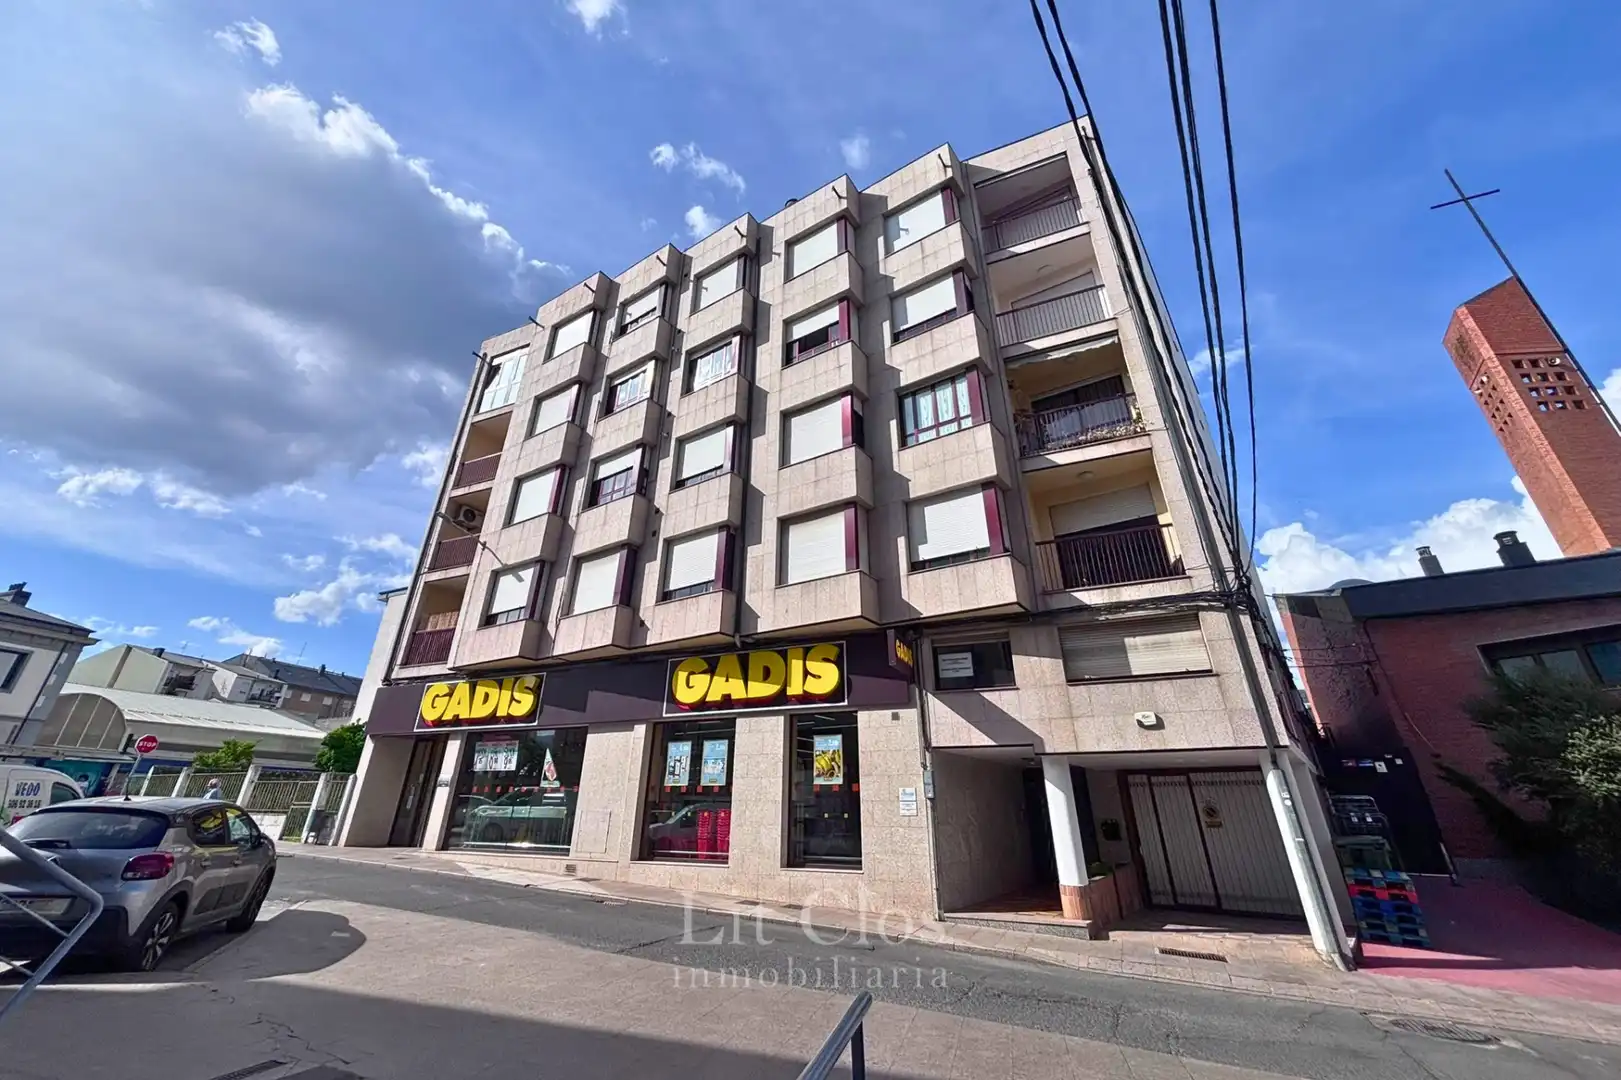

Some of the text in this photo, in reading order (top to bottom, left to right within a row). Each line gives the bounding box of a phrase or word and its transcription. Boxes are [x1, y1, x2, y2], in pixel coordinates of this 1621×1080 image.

[672, 643, 840, 704] GADIS
[421, 675, 536, 722] GADIS
[138, 740, 157, 748] STOP
